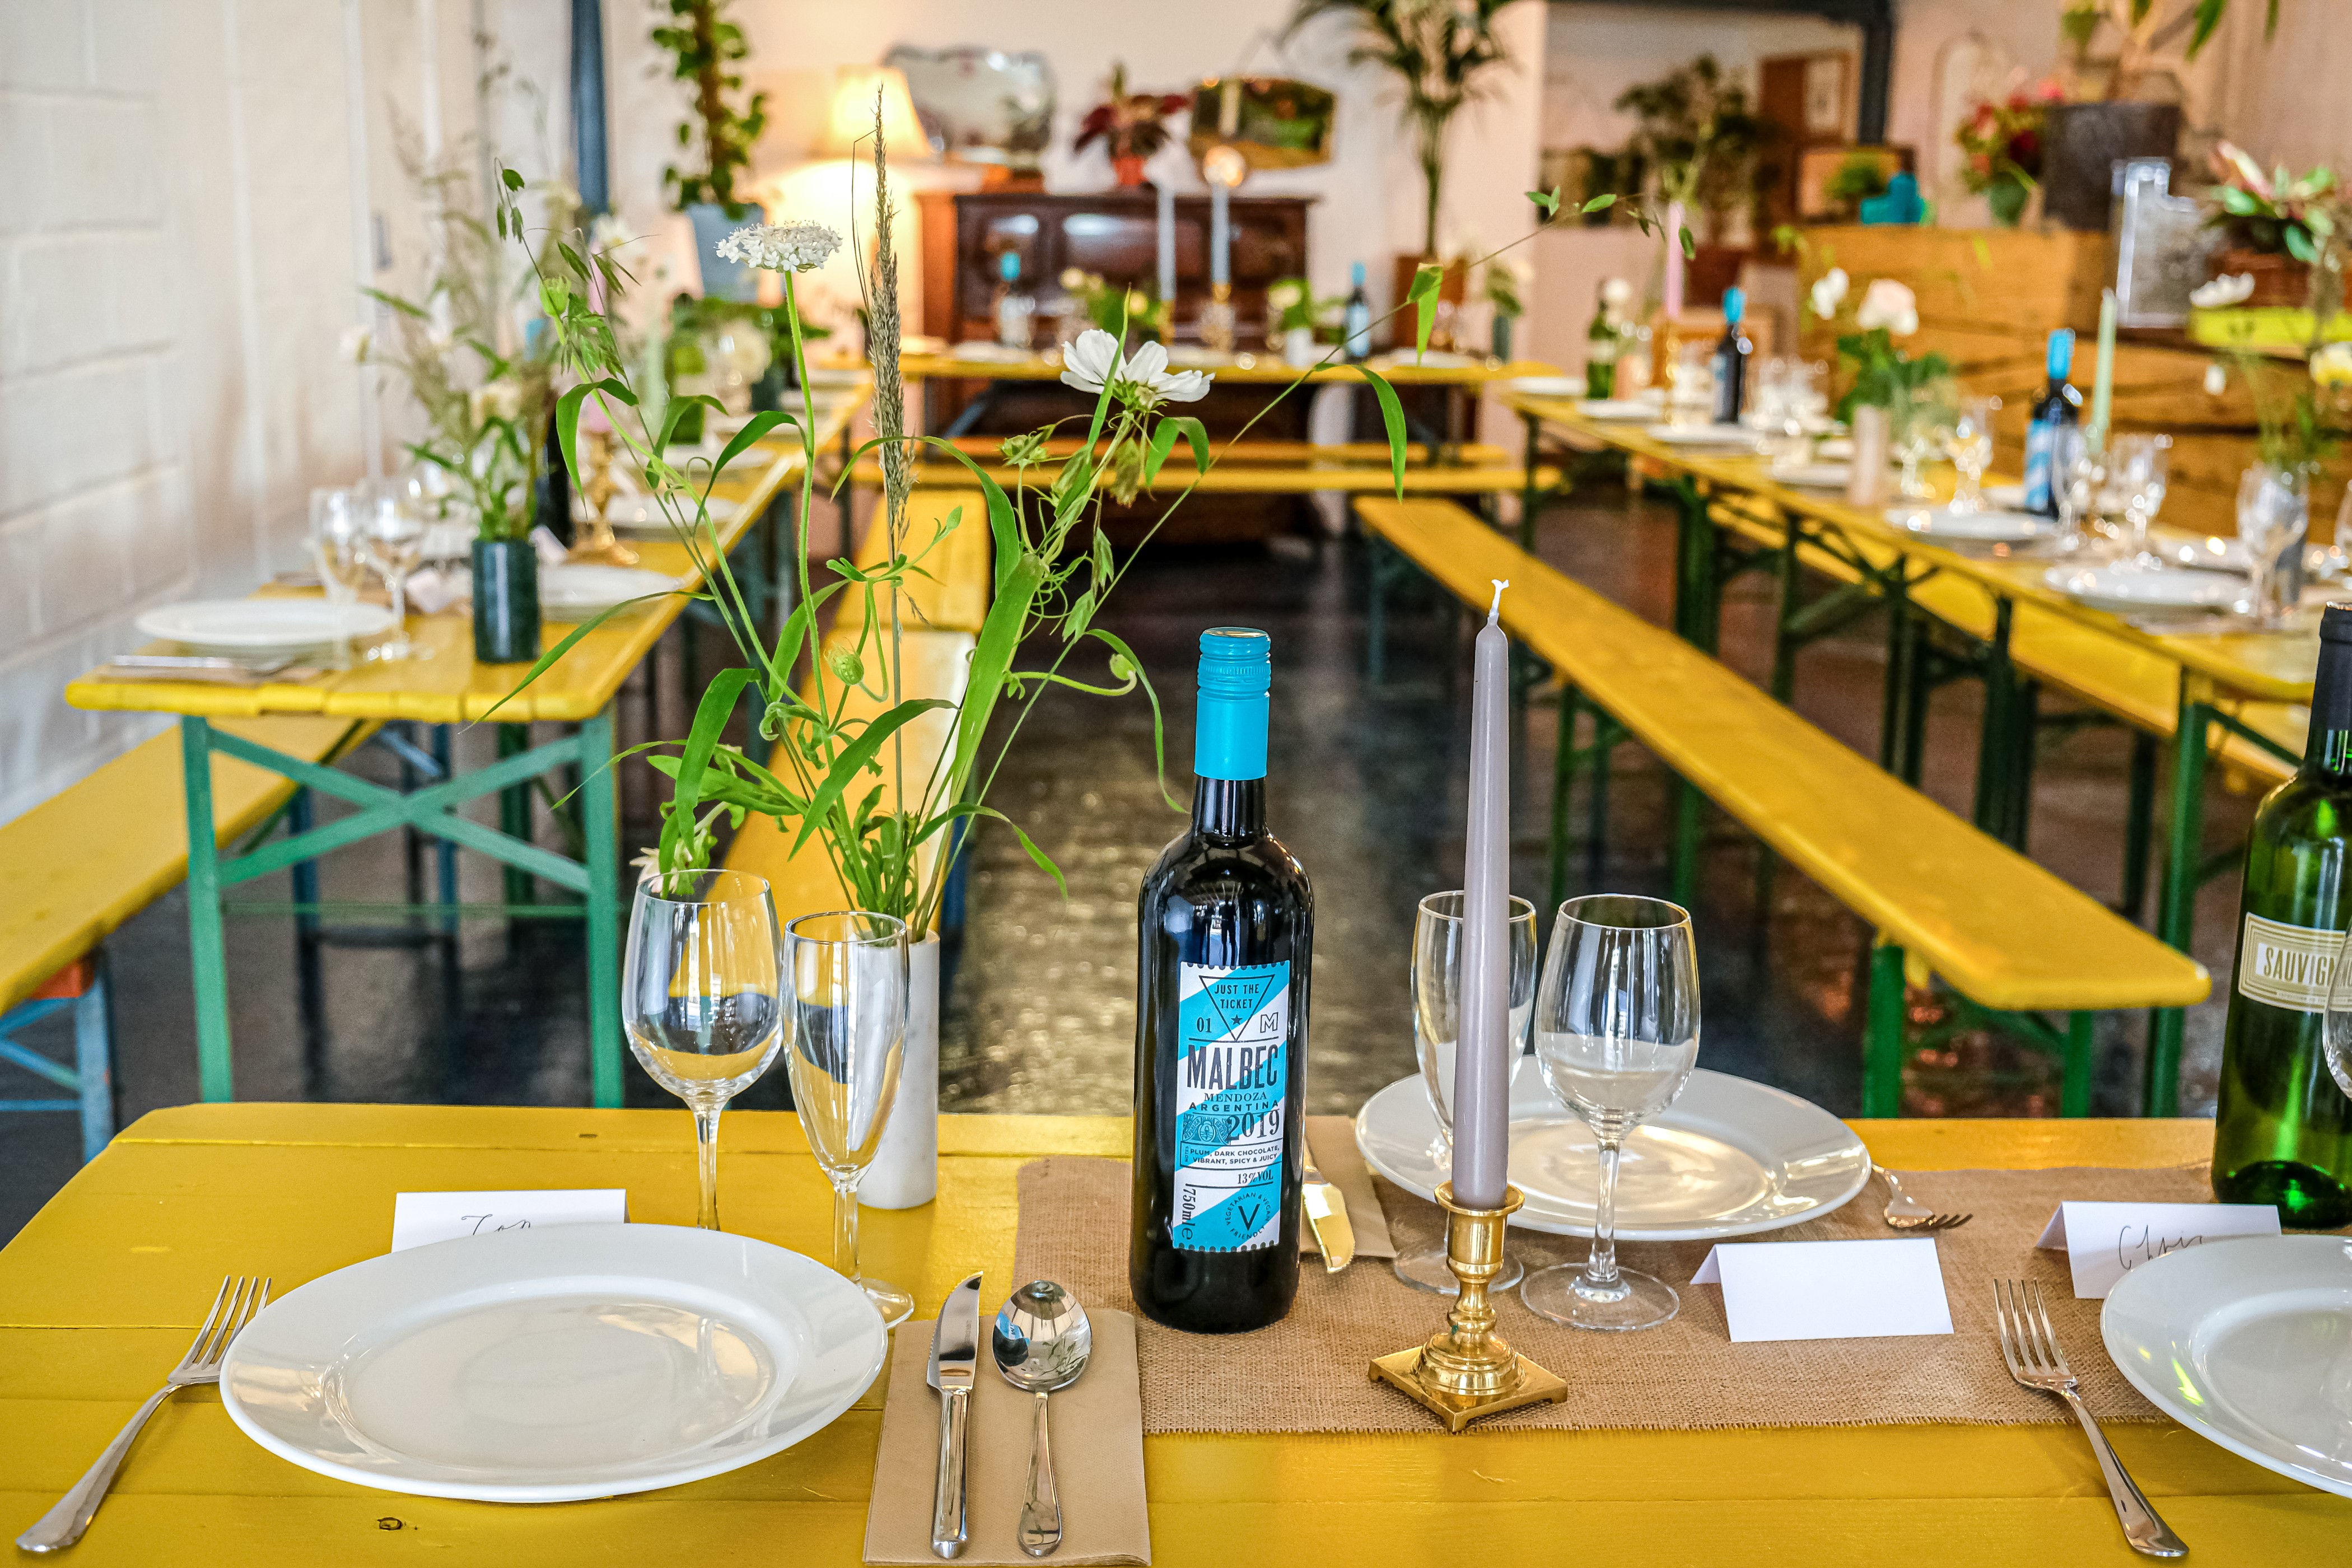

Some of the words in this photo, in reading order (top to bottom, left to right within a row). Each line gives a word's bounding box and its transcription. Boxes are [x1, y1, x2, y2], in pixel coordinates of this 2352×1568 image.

[1215, 984, 1238, 995] JUST
[1243, 984, 1259, 995] THE
[1220, 999, 1253, 1009] TICKET
[1197, 1017, 1212, 1033] 01
[1260, 1012, 1278, 1033] M
[1187, 1044, 1278, 1090] MALBEC
[1204, 1092, 1267, 1102] MENDOZA
[1189, 1100, 1278, 1112] ARGENTINA
[1225, 1109, 1280, 1141] 2019
[1238, 1145, 1280, 1156] CHOCOLATE,
[1259, 1153, 1277, 1161] JUICY
[1225, 1192, 1256, 1226] VEGETARIAN
[1263, 1197, 1271, 1221] VEGAN
[1238, 1203, 1261, 1231] V
[1230, 1225, 1264, 1239] FRIENDLY
